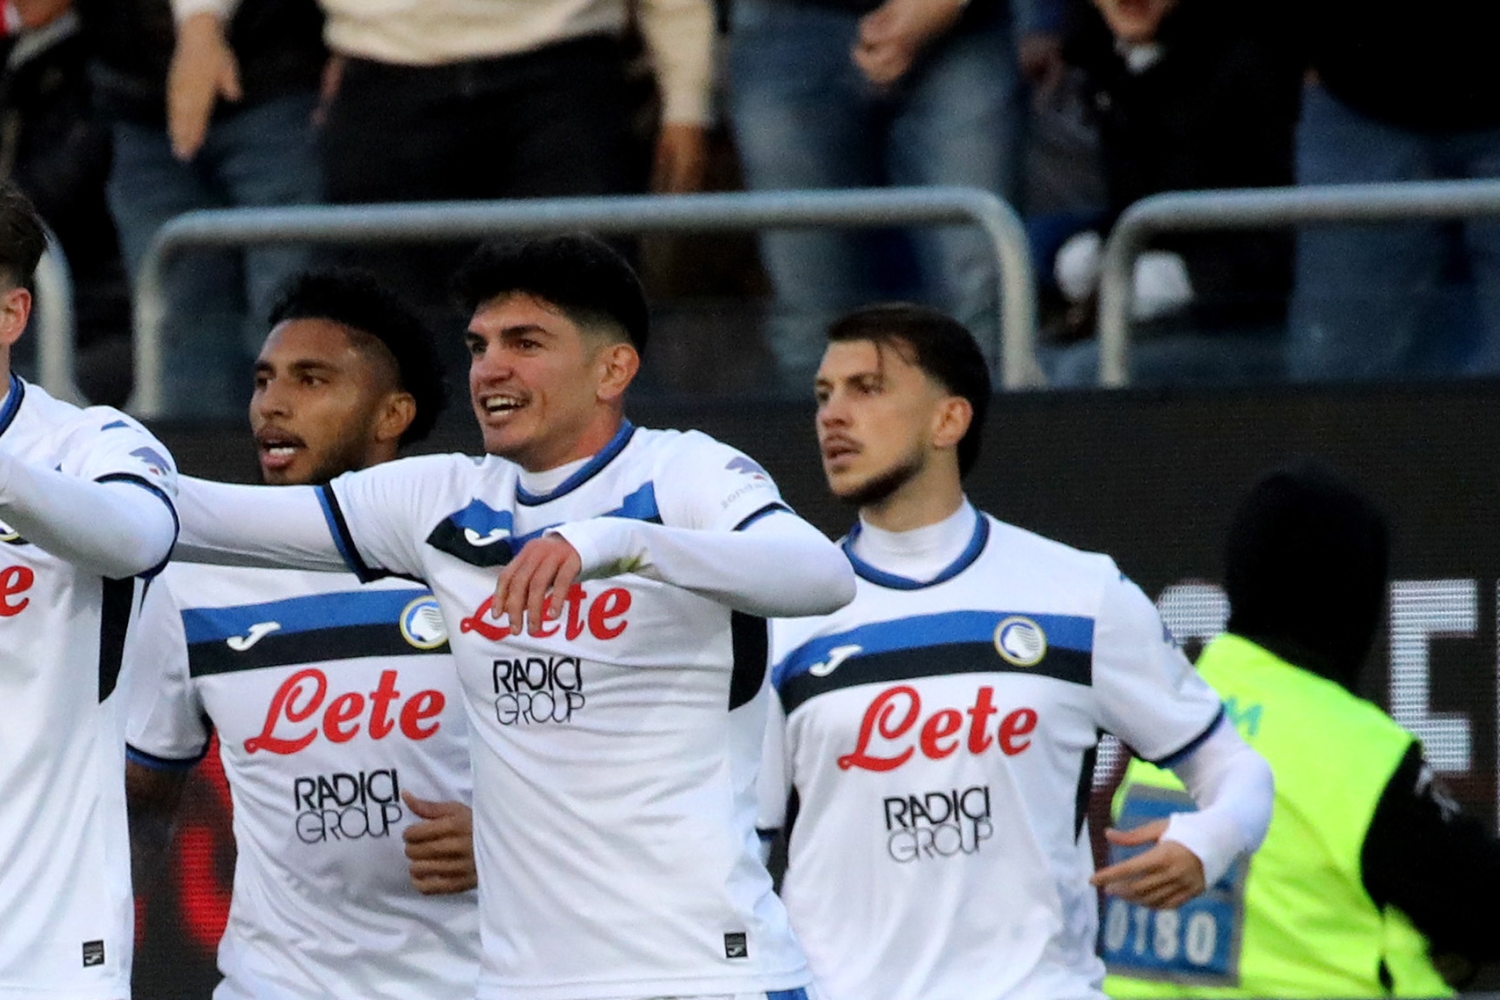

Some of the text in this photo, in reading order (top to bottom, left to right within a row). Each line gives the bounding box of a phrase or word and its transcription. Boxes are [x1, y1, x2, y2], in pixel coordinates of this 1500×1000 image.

[493, 655, 583, 696] RADICI
[244, 667, 446, 755] Lete
[495, 690, 586, 726] GROUP
[837, 684, 1038, 772] Lete
[293, 768, 400, 811] RADICI
[882, 786, 991, 830] RADICI
[296, 803, 402, 844] GROUP
[887, 816, 994, 863] GROUP
